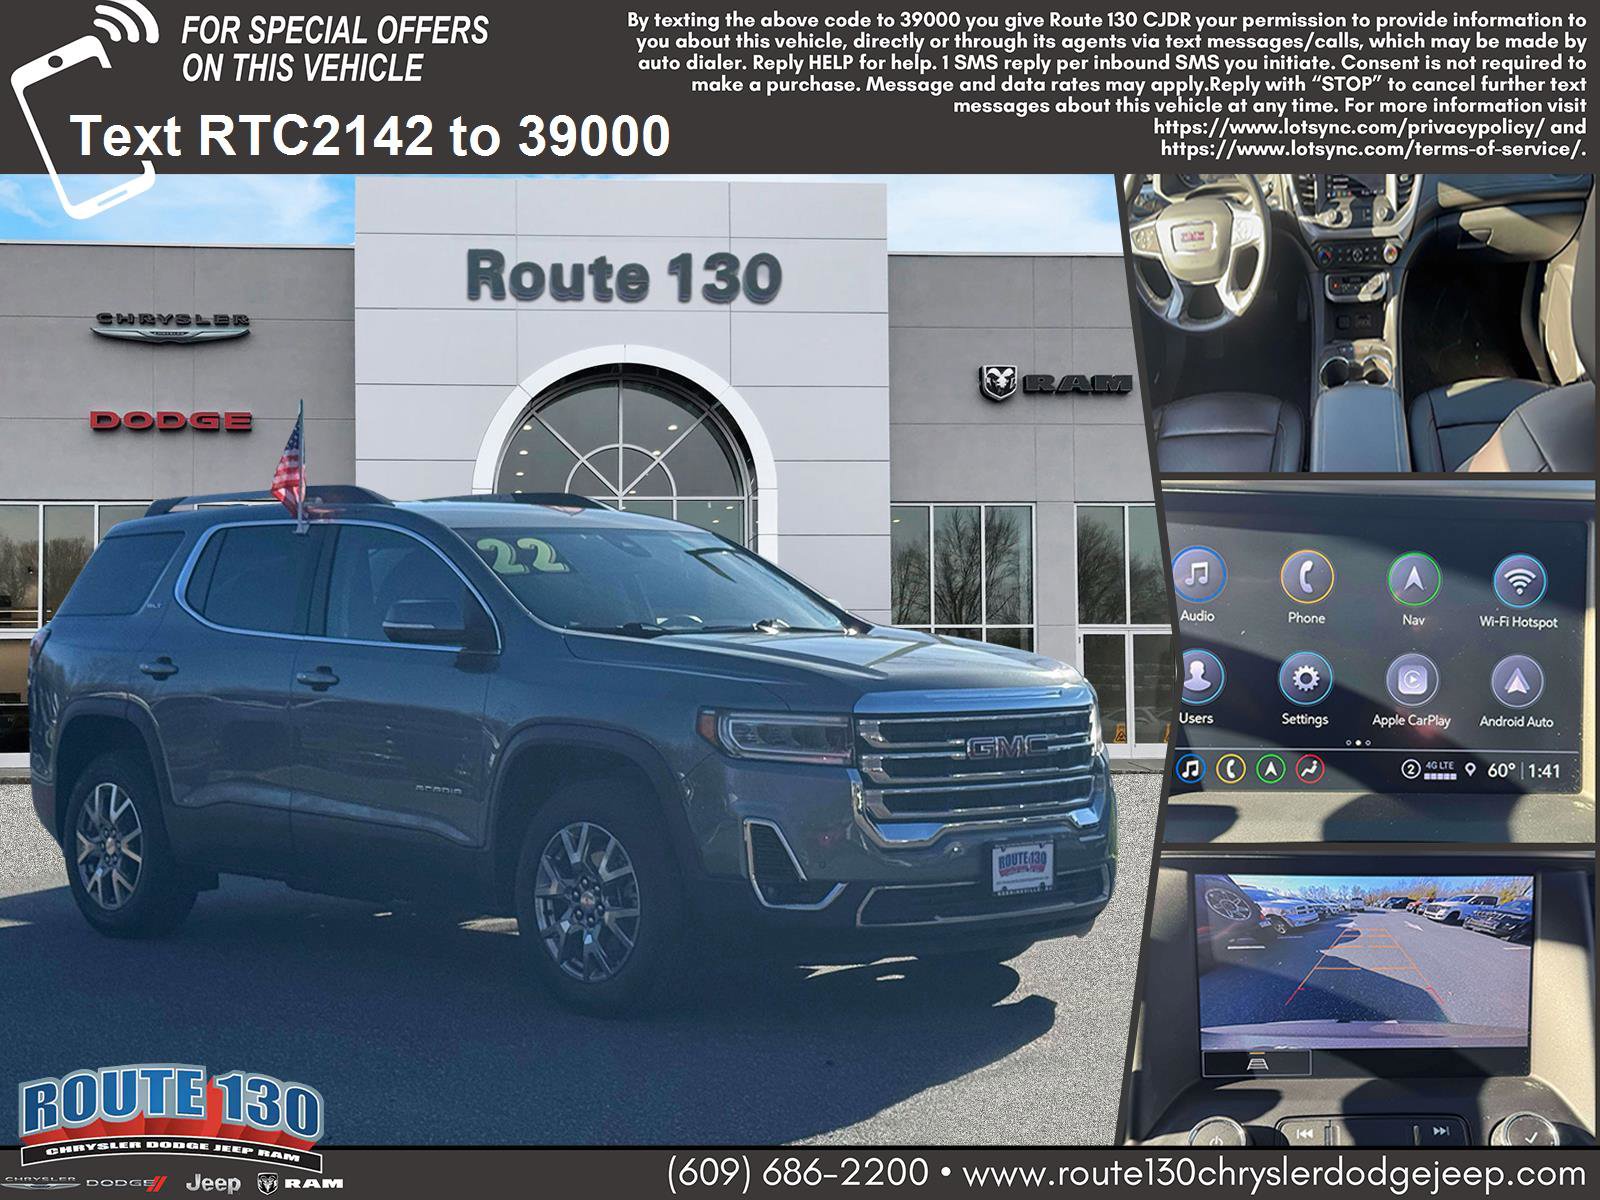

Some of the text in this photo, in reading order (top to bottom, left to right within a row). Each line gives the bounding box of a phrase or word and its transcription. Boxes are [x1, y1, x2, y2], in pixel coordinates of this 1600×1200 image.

[467, 248, 782, 304] Route 130
[96, 312, 250, 326] CHRYSLER
[1023, 374, 1133, 393] RAM
[90, 410, 252, 431] DODGE
[476, 537, 571, 576] 22
[1180, 610, 1215, 623] Audio
[1288, 612, 1326, 625] Phone
[1402, 613, 1426, 626] Nav
[1480, 616, 1558, 630] Wi-Fi Hotspot
[1179, 712, 1214, 725] Users
[1282, 713, 1328, 728] Settings
[1373, 714, 1451, 729] Apple CarPlay
[1479, 715, 1554, 729] Android Auto
[967, 733, 1049, 760] GMC
[1425, 760, 1454, 770] 4G LTE
[1488, 762, 1516, 778] 60°
[1528, 764, 1560, 779] 1:41
[999, 850, 1047, 869] ROUTE 130
